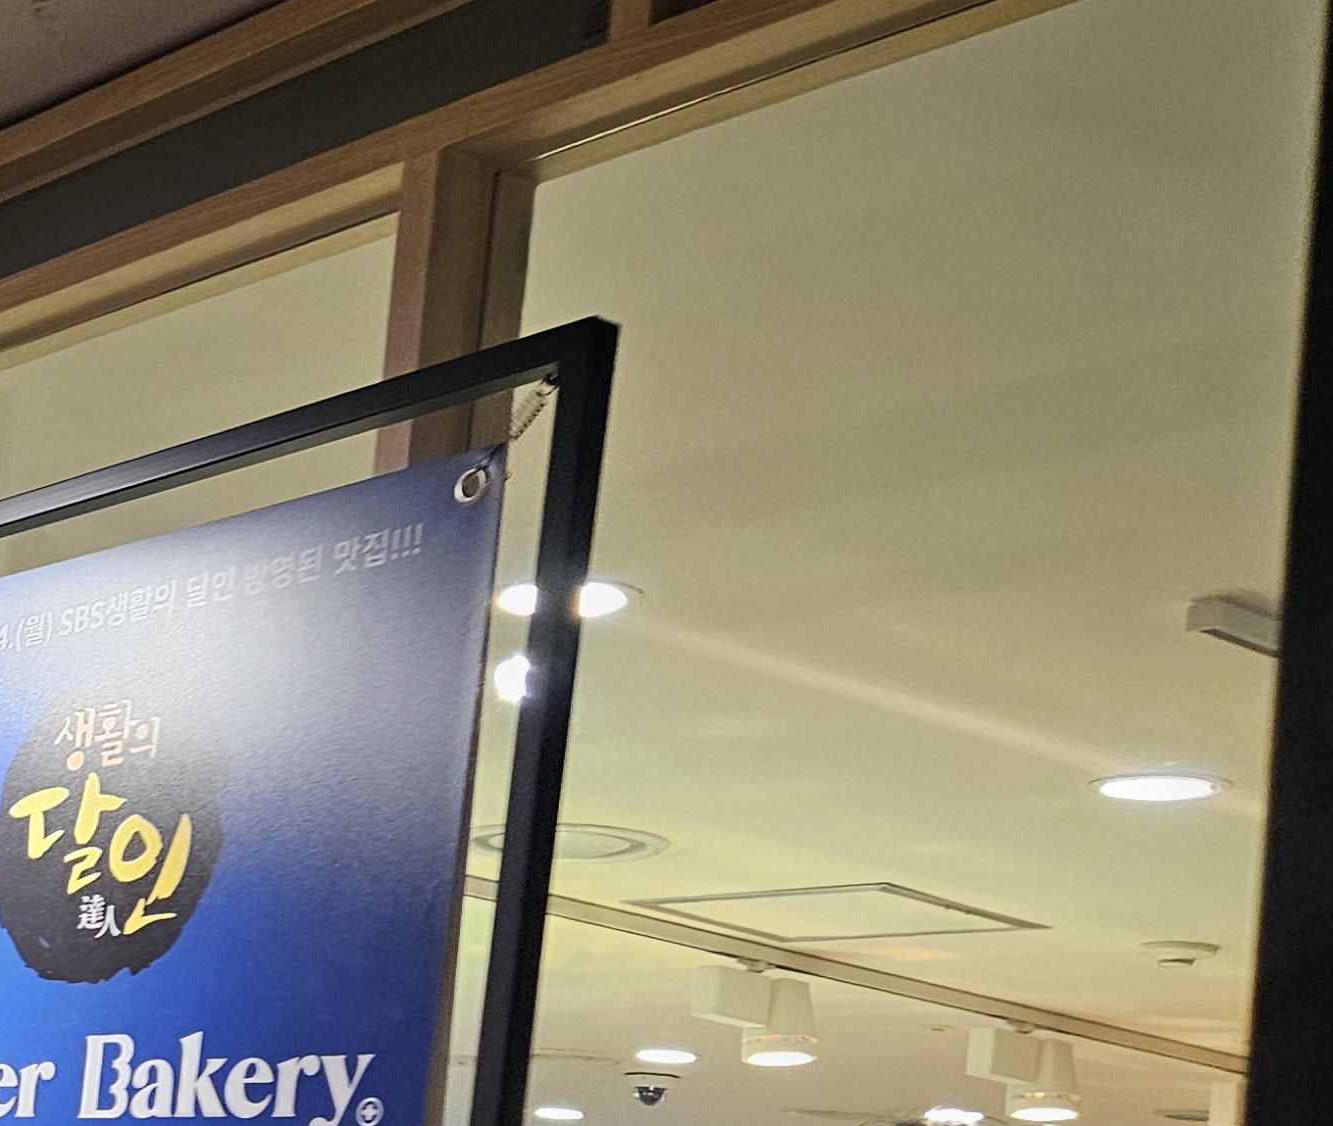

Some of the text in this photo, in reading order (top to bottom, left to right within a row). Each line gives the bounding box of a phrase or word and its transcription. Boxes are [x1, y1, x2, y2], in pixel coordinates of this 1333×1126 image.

[184, 565, 237, 613] 달인
[242, 543, 324, 596] 방영된
[333, 522, 424, 576] 맛집!!!
[53, 698, 162, 771] 생활의
[8, 772, 193, 936] 달인
[78, 893, 122, 939] 達人
